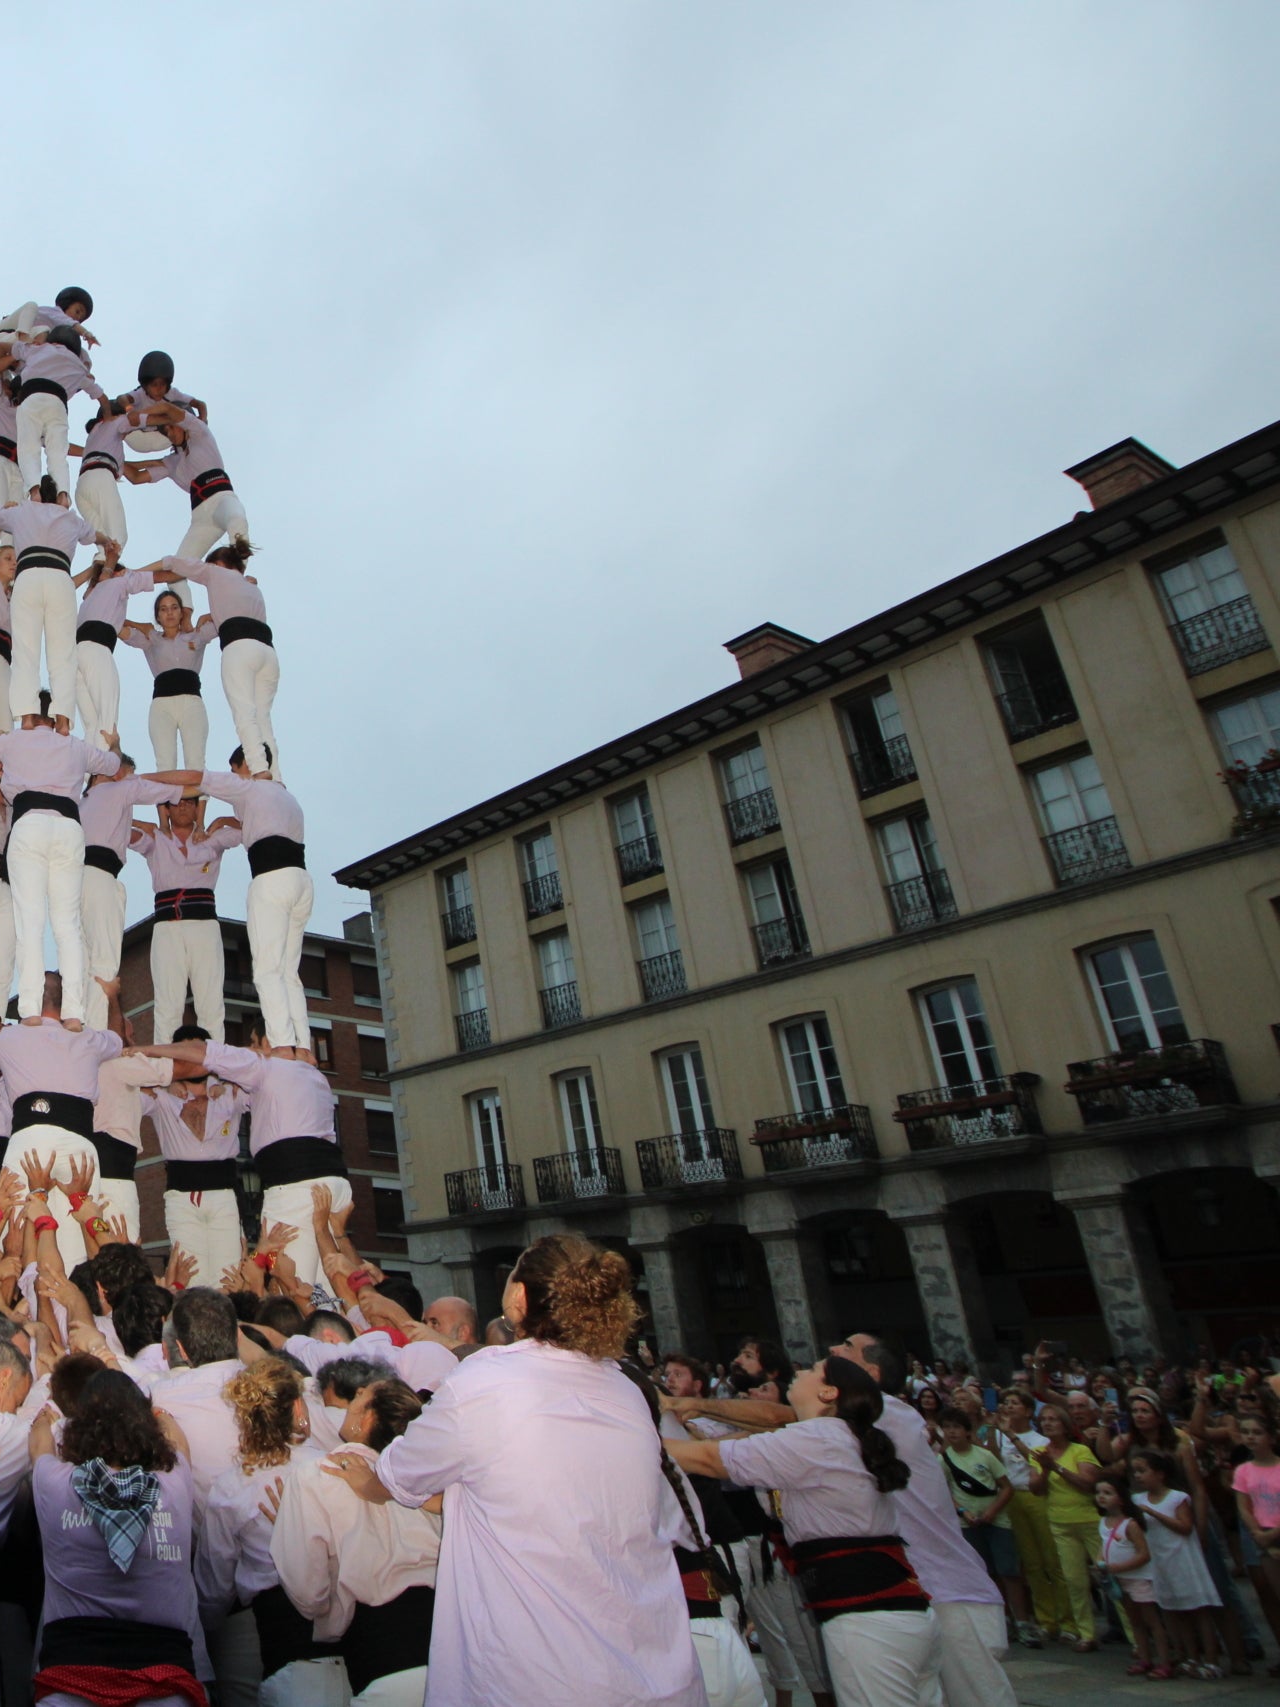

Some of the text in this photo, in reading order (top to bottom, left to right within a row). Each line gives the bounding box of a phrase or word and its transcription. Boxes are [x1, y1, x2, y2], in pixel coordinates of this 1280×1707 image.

[152, 1512, 173, 1528] SOM
[154, 1528, 168, 1543] LA
[156, 1544, 182, 1561] COLLA
